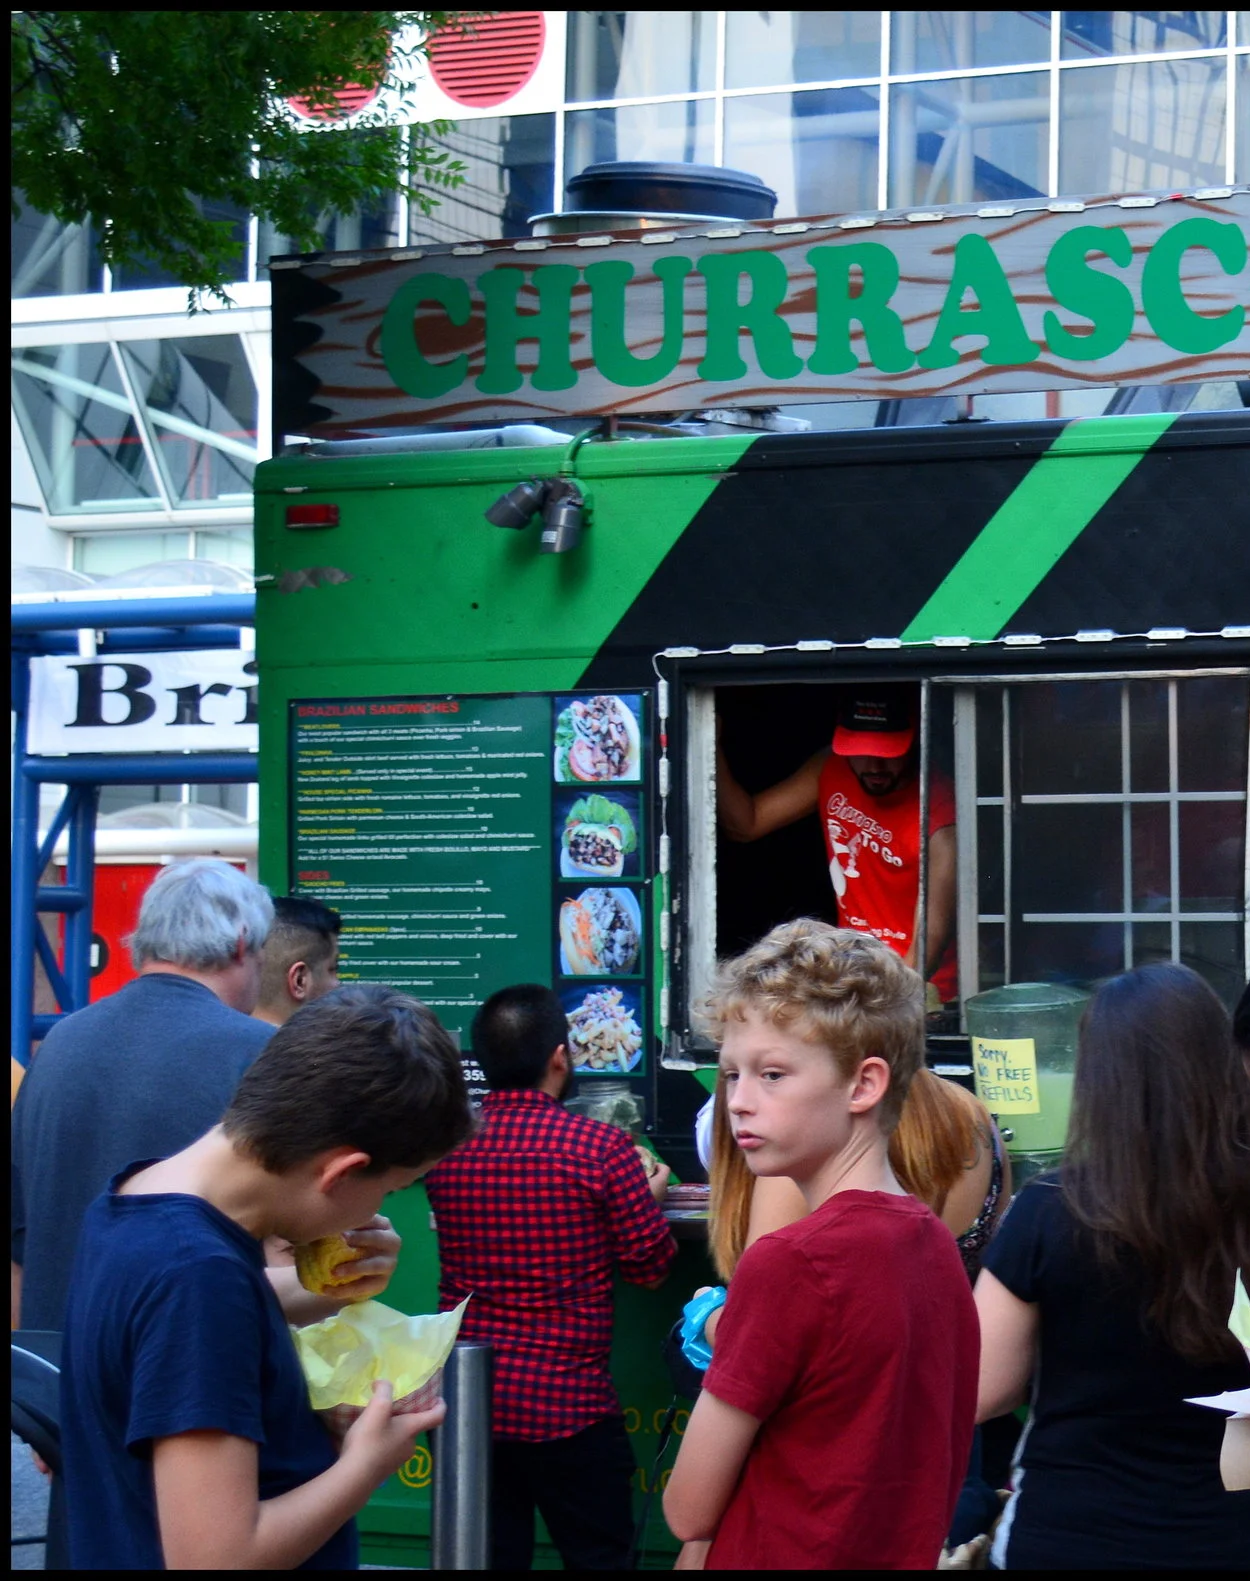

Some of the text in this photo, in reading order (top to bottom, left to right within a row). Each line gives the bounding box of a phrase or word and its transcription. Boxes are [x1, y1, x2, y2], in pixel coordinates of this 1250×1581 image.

[64, 662, 259, 727] Bri
[297, 702, 460, 717] BRAZILIAN SANDWICHES
[861, 831, 903, 867] To Go
[996, 1067, 1033, 1081] FREE
[980, 1086, 1033, 1102] REFILLS
